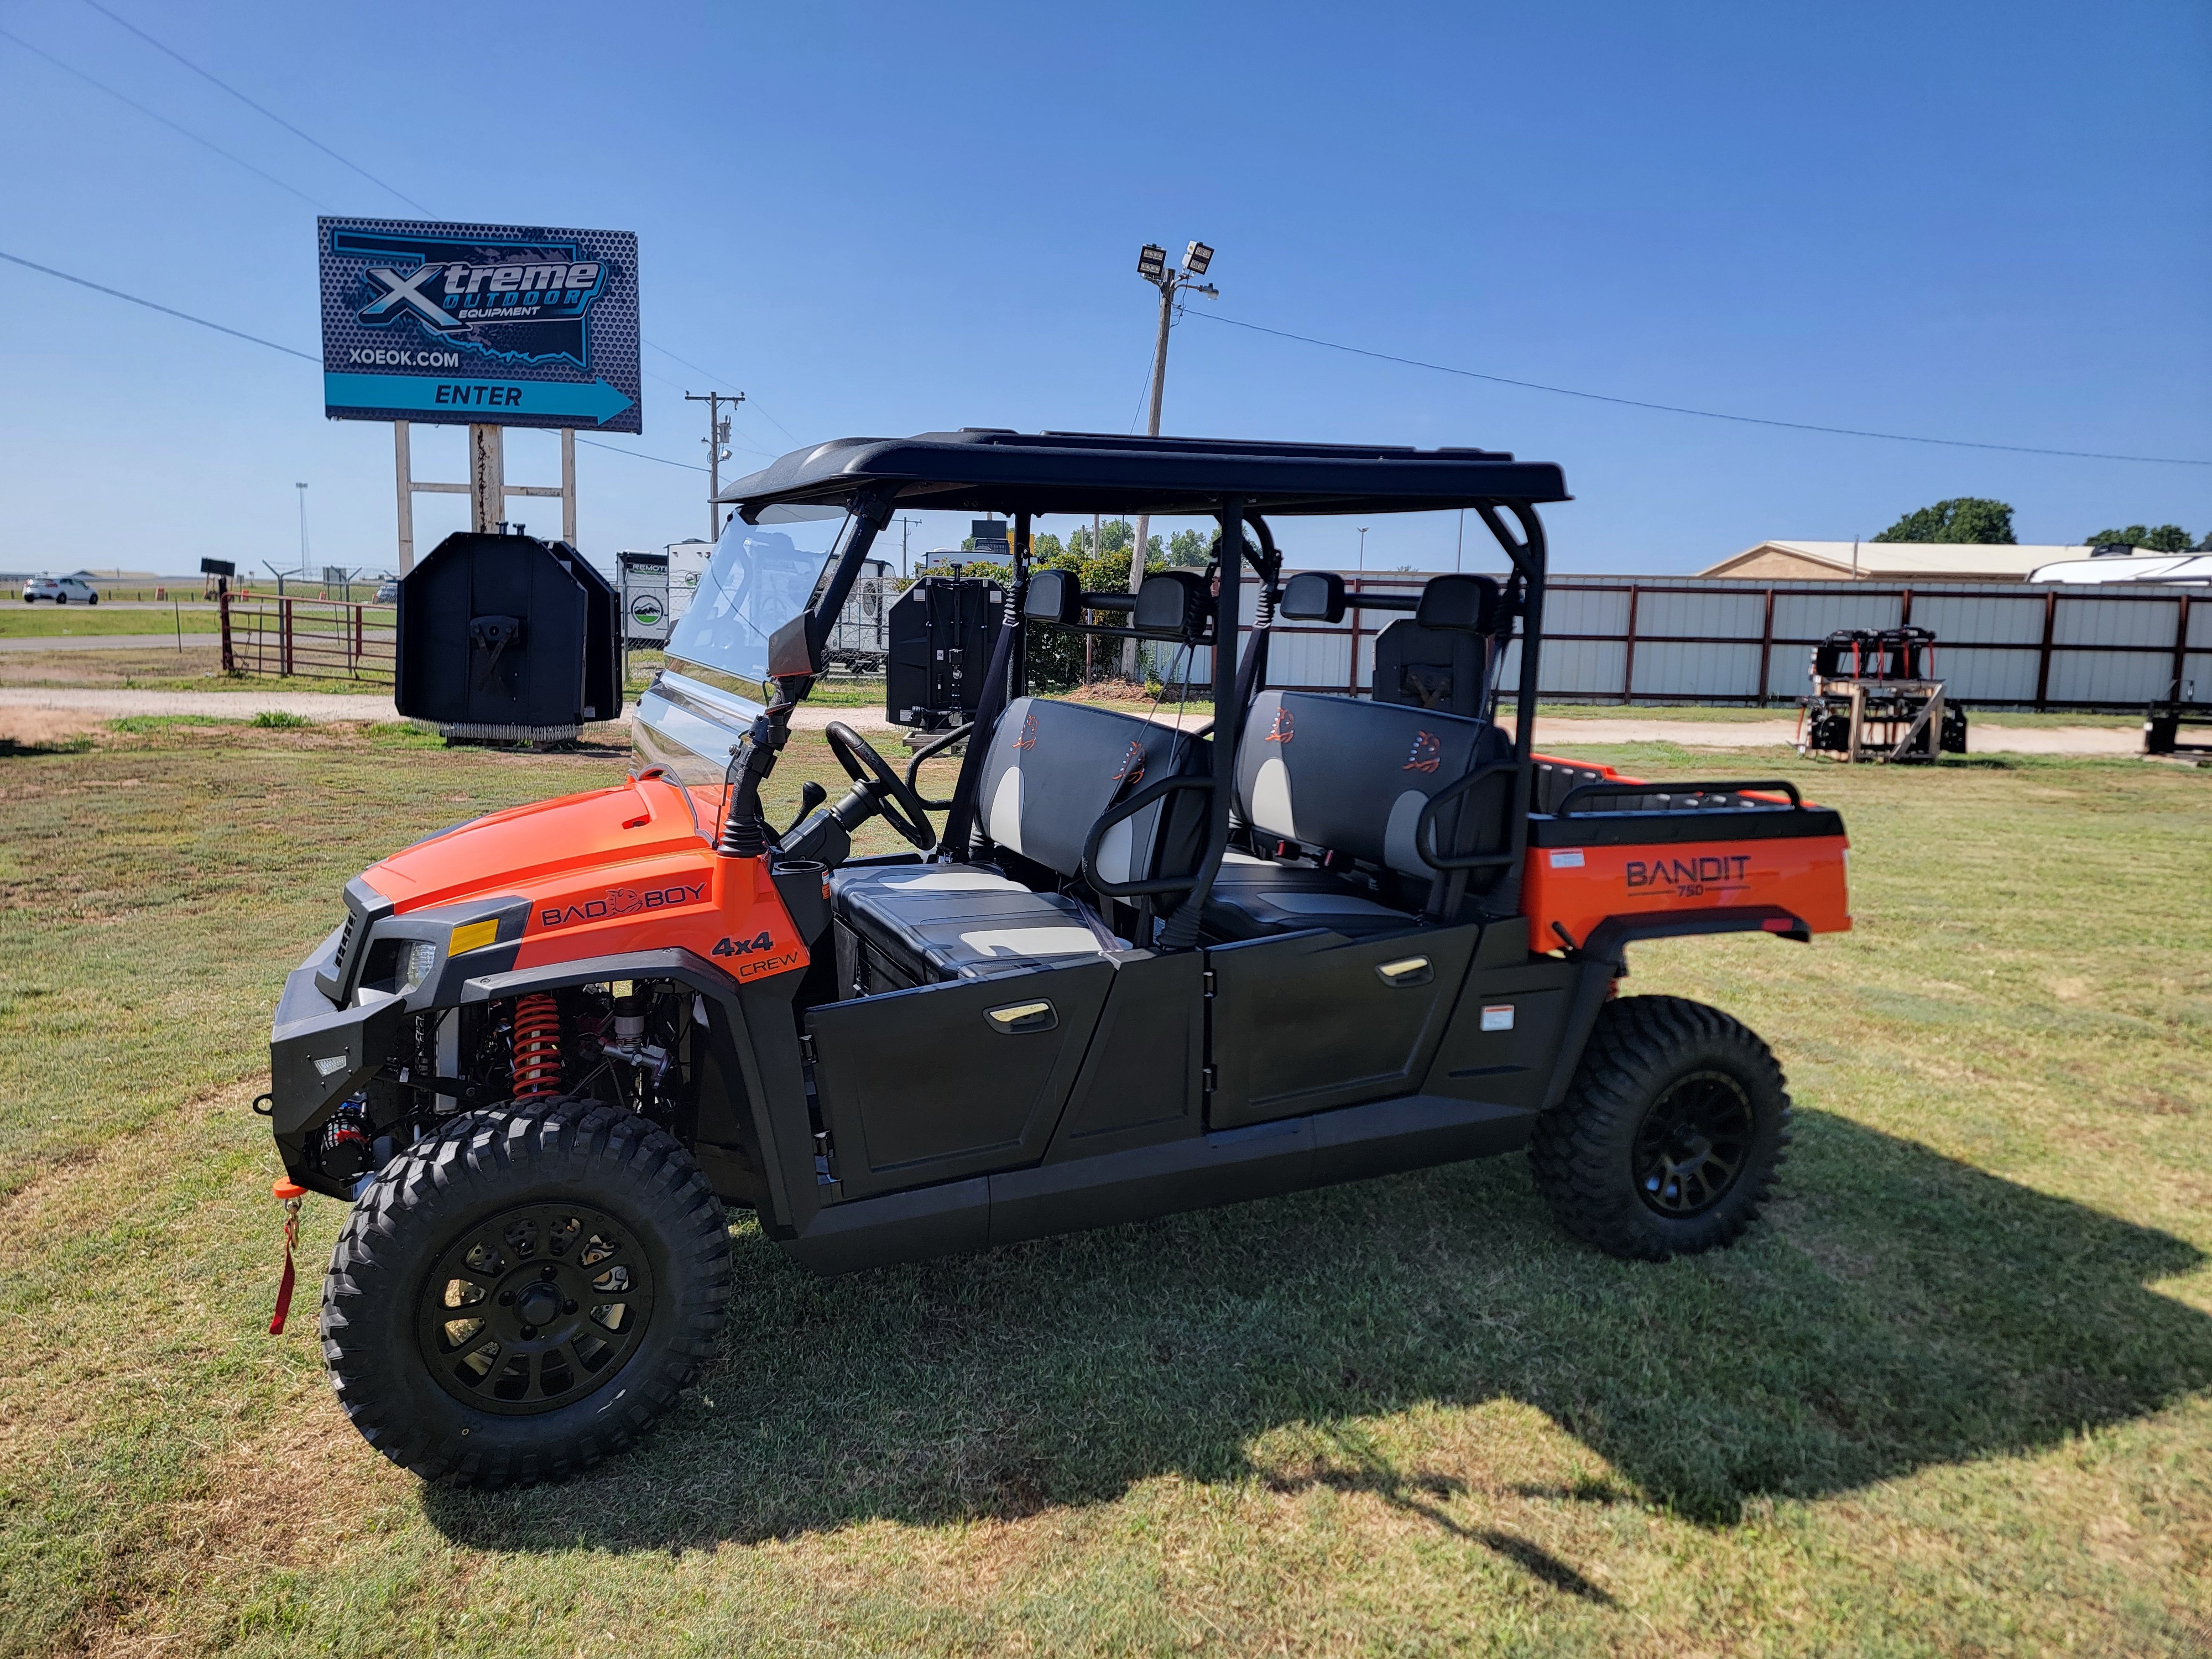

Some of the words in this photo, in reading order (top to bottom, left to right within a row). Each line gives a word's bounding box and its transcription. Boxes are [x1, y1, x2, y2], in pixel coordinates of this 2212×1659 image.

[361, 262, 599, 327] Xtreme
[442, 290, 581, 309] OUTDOOR
[458, 306, 541, 319] EQUIPMENT
[348, 347, 459, 368] XOEOK.COM
[435, 384, 523, 407] ENTER
[1626, 855, 1752, 887] BANDIT
[1677, 884, 1704, 898] 750
[542, 900, 607, 926] BAD
[645, 882, 706, 908] BOY
[711, 931, 774, 957] 4x4
[739, 952, 798, 977] CREW
